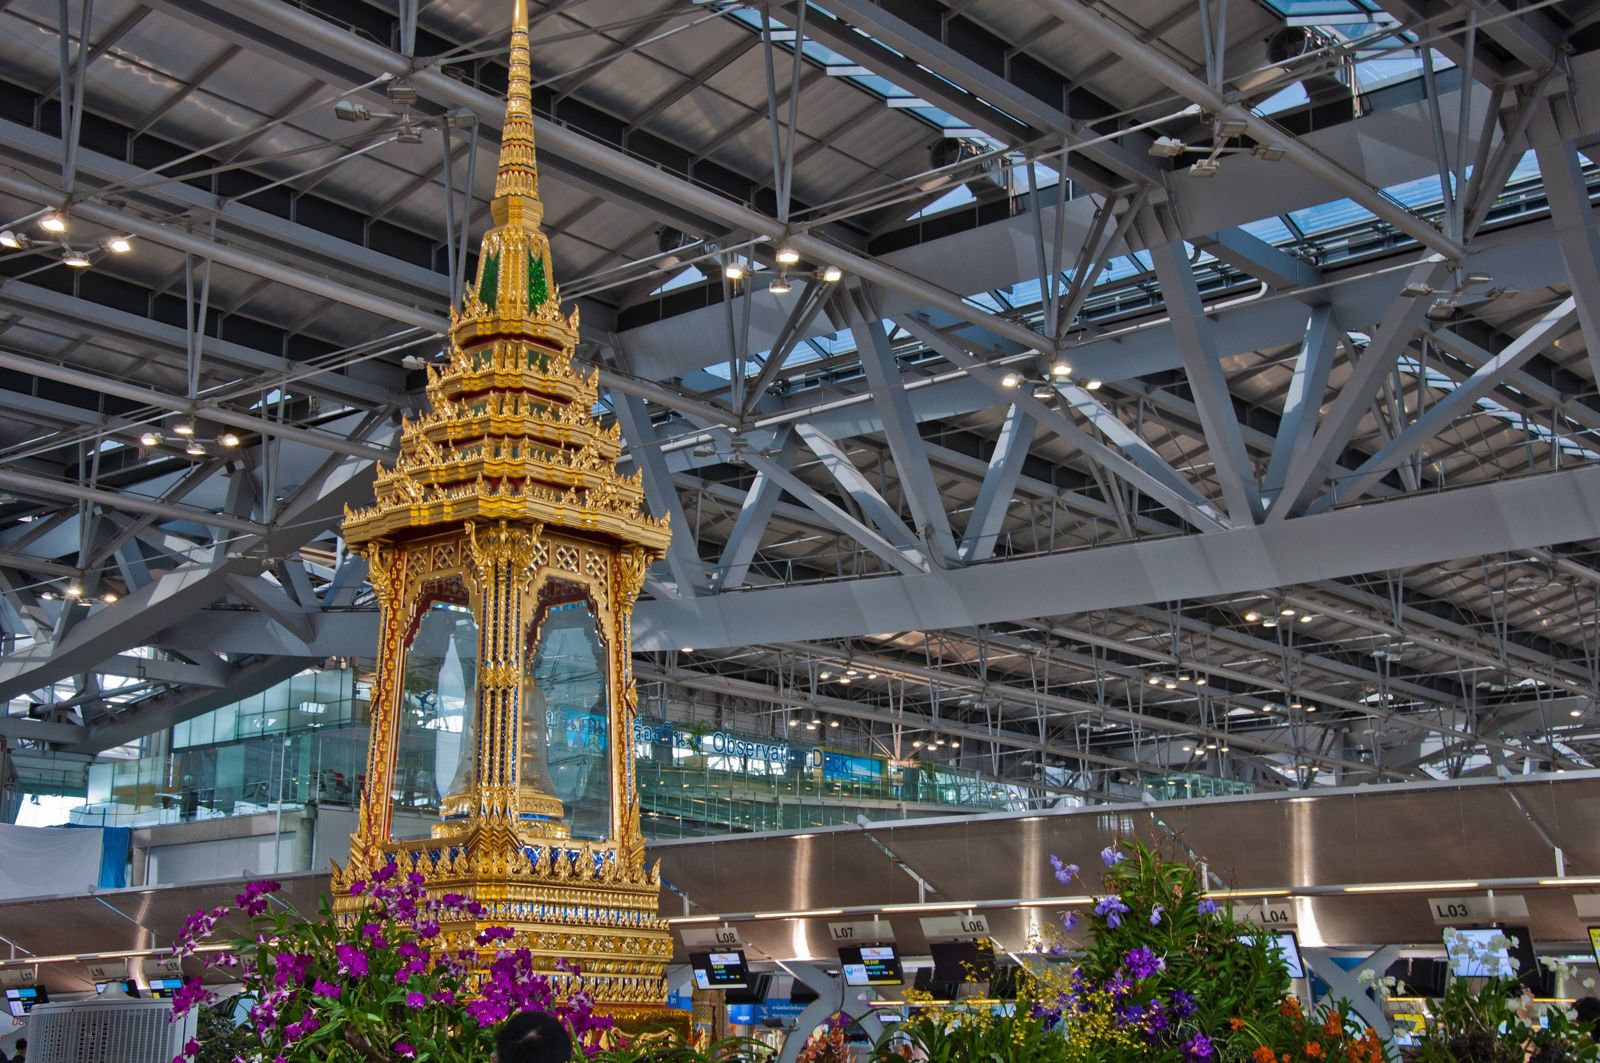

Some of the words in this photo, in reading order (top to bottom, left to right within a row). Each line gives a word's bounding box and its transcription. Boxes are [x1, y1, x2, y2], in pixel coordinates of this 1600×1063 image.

[712, 731, 809, 766] Observation
[811, 746, 850, 774] Deck
[1260, 910, 1289, 923] L04
[1436, 903, 1469, 918] L03
[960, 919, 985, 933] L06
[715, 932, 737, 944] L08
[833, 927, 854, 939] L07
[90, 968, 106, 977] L16
[165, 962, 180, 972] L15
[20, 972, 33, 982] L17
